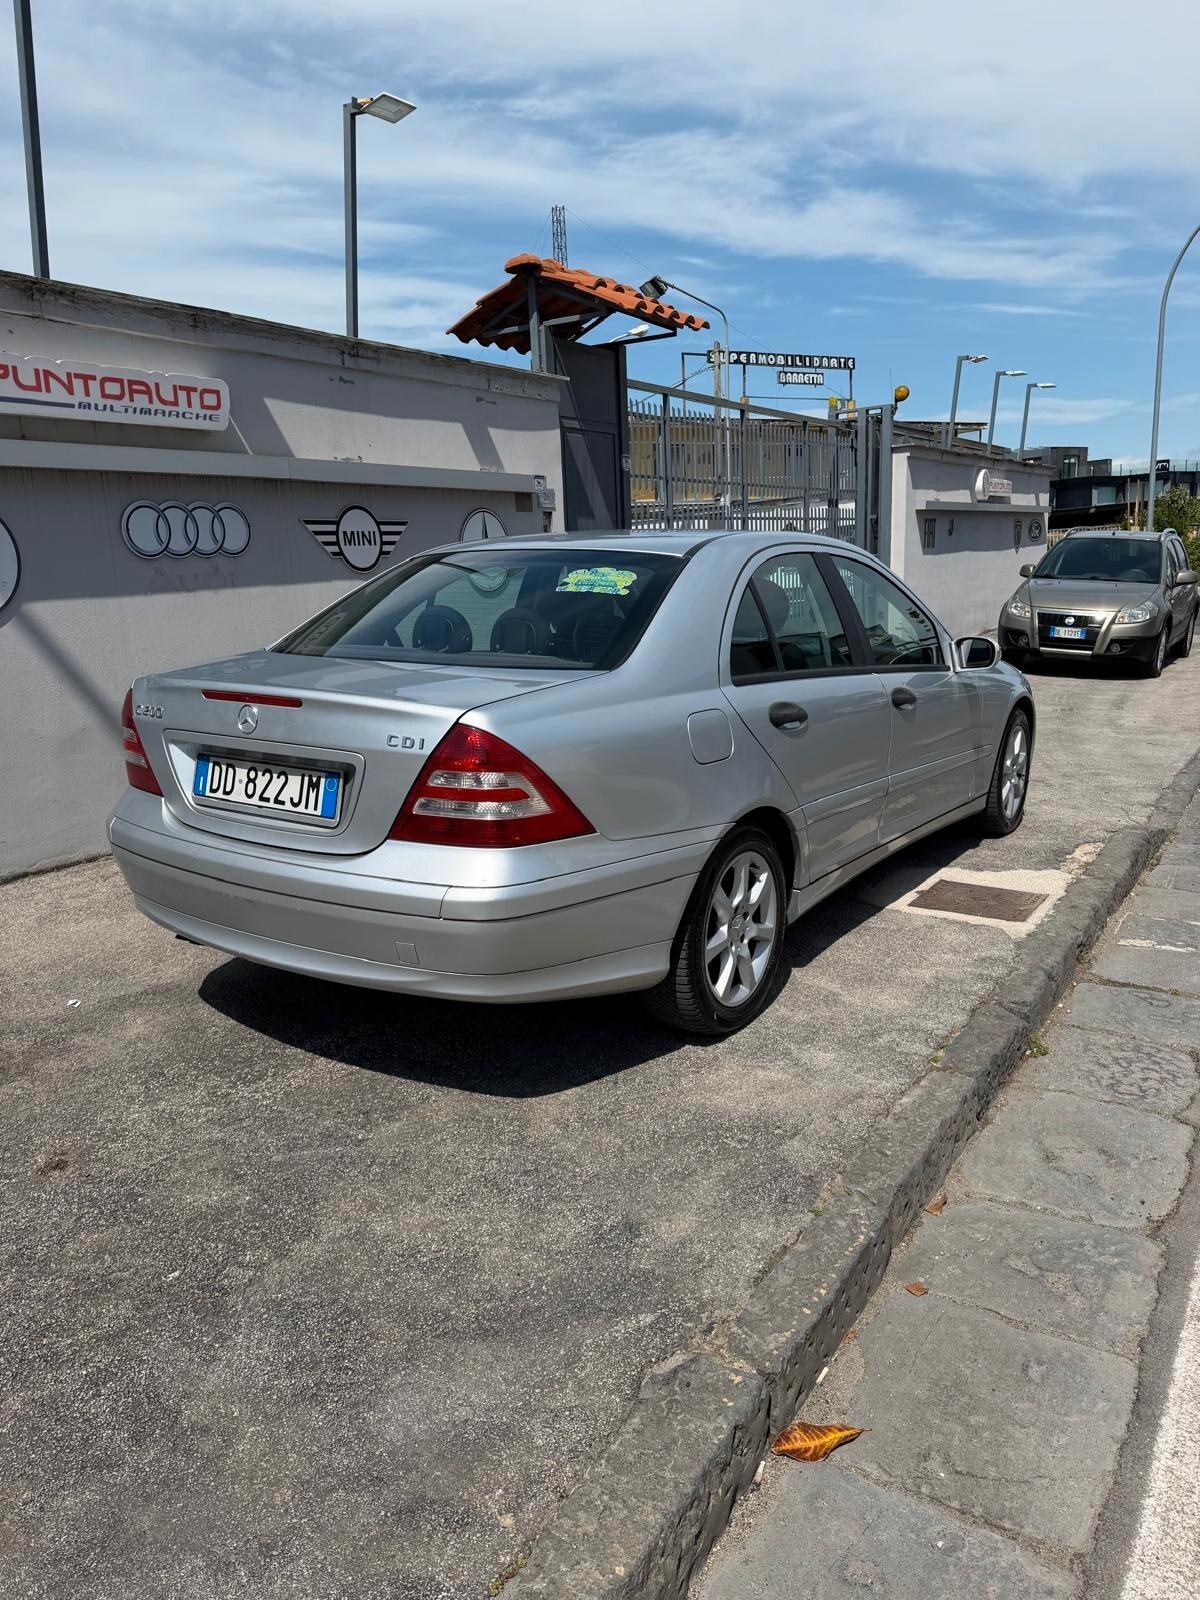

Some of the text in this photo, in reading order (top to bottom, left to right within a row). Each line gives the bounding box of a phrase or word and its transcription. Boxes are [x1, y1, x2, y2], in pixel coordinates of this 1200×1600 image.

[779, 372, 823, 384] BARRETTA
[77, 401, 220, 423] MULTIMARCHE
[342, 530, 377, 547] MINI
[387, 734, 425, 750] CDI
[209, 761, 322, 811] DD 822JM
